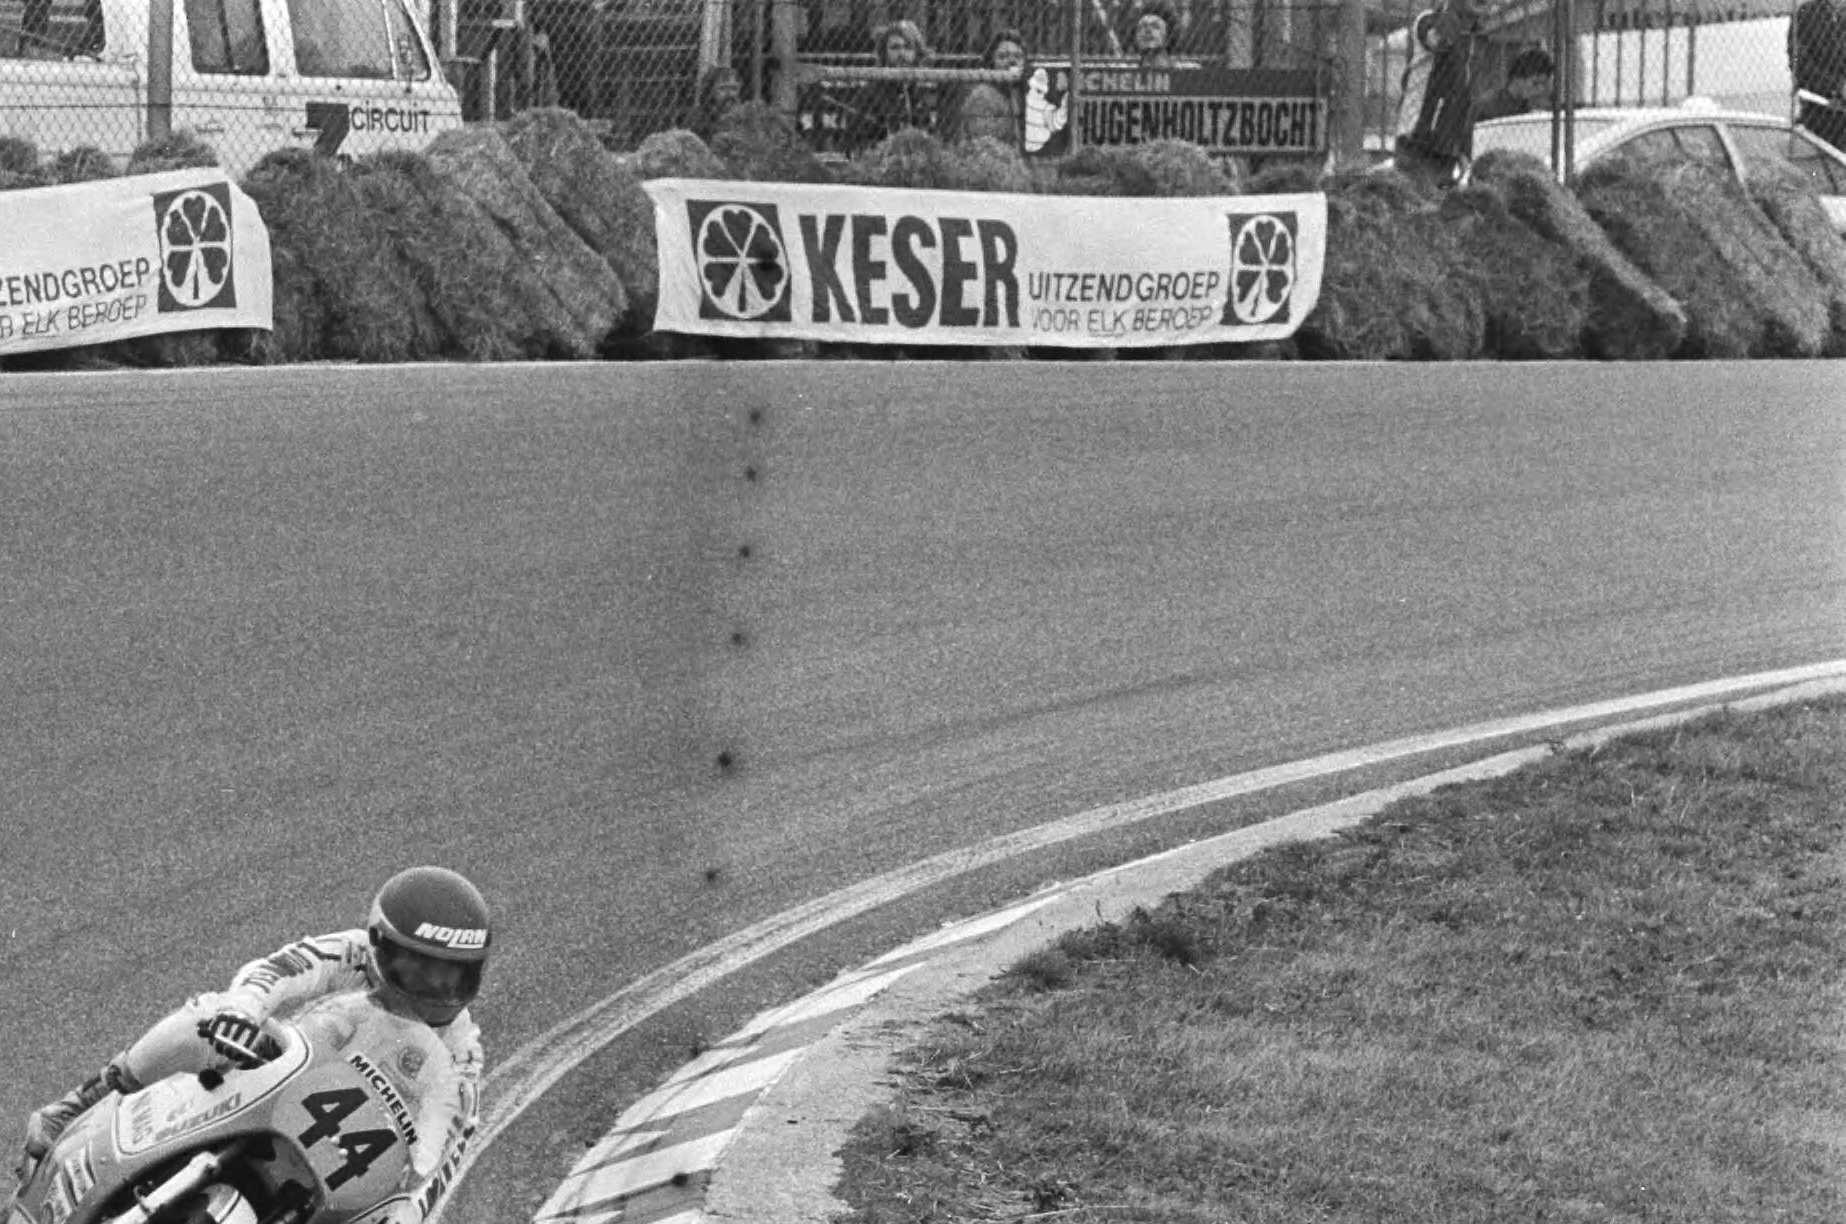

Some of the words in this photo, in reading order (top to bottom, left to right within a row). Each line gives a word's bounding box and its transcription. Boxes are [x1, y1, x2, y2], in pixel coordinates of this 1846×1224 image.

[1056, 71, 1170, 93] MCHELIN
[798, 214, 1021, 328] KESER
[1029, 271, 1220, 302] UITZENDGROEP
[22, 308, 60, 335] ELK
[67, 293, 147, 330] BEROEP
[1087, 308, 1130, 332] ELK
[1132, 305, 1214, 332] BEROEP
[414, 922, 489, 949] NOLAN
[349, 1054, 418, 1146] MICHELIN
[298, 1087, 398, 1192] 44
